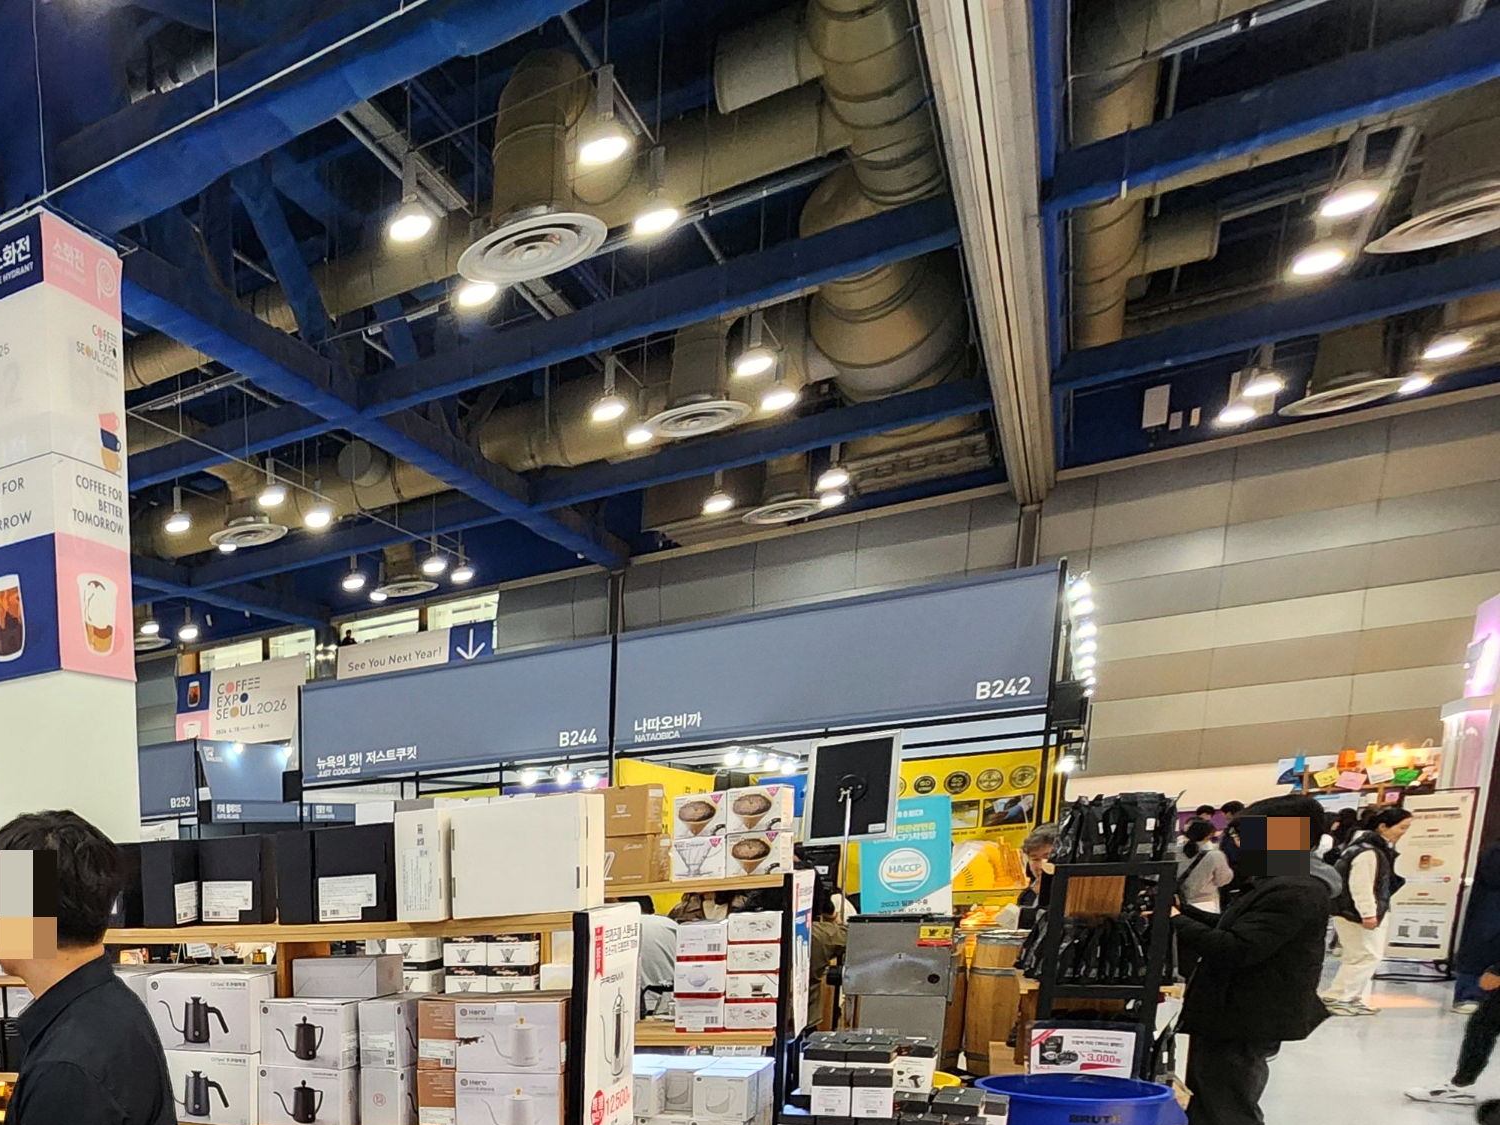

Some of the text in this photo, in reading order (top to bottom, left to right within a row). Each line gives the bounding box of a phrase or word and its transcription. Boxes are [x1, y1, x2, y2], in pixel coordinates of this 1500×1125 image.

[52, 238, 85, 273] 소화전
[3, 262, 34, 283] HYDRANT
[2, 477, 25, 495] FOR
[75, 475, 123, 503] COFFEE FOR
[99, 499, 123, 519] BETTER
[72, 508, 124, 536] TOMORROW
[347, 646, 442, 672] See You Next Year!
[976, 676, 1031, 700] B242
[256, 698, 287, 715] 2026
[634, 711, 702, 733] 나따오비까
[559, 728, 597, 747] B244
[634, 730, 680, 744] NATAOBICA
[316, 745, 417, 769] 뉴욕의 맛! 저스트쿠킷
[170, 795, 191, 808] B252
[888, 863, 921, 873] HACCP
[469, 1008, 486, 1016] Hero
[1068, 1114, 1121, 1125] BRUTE
